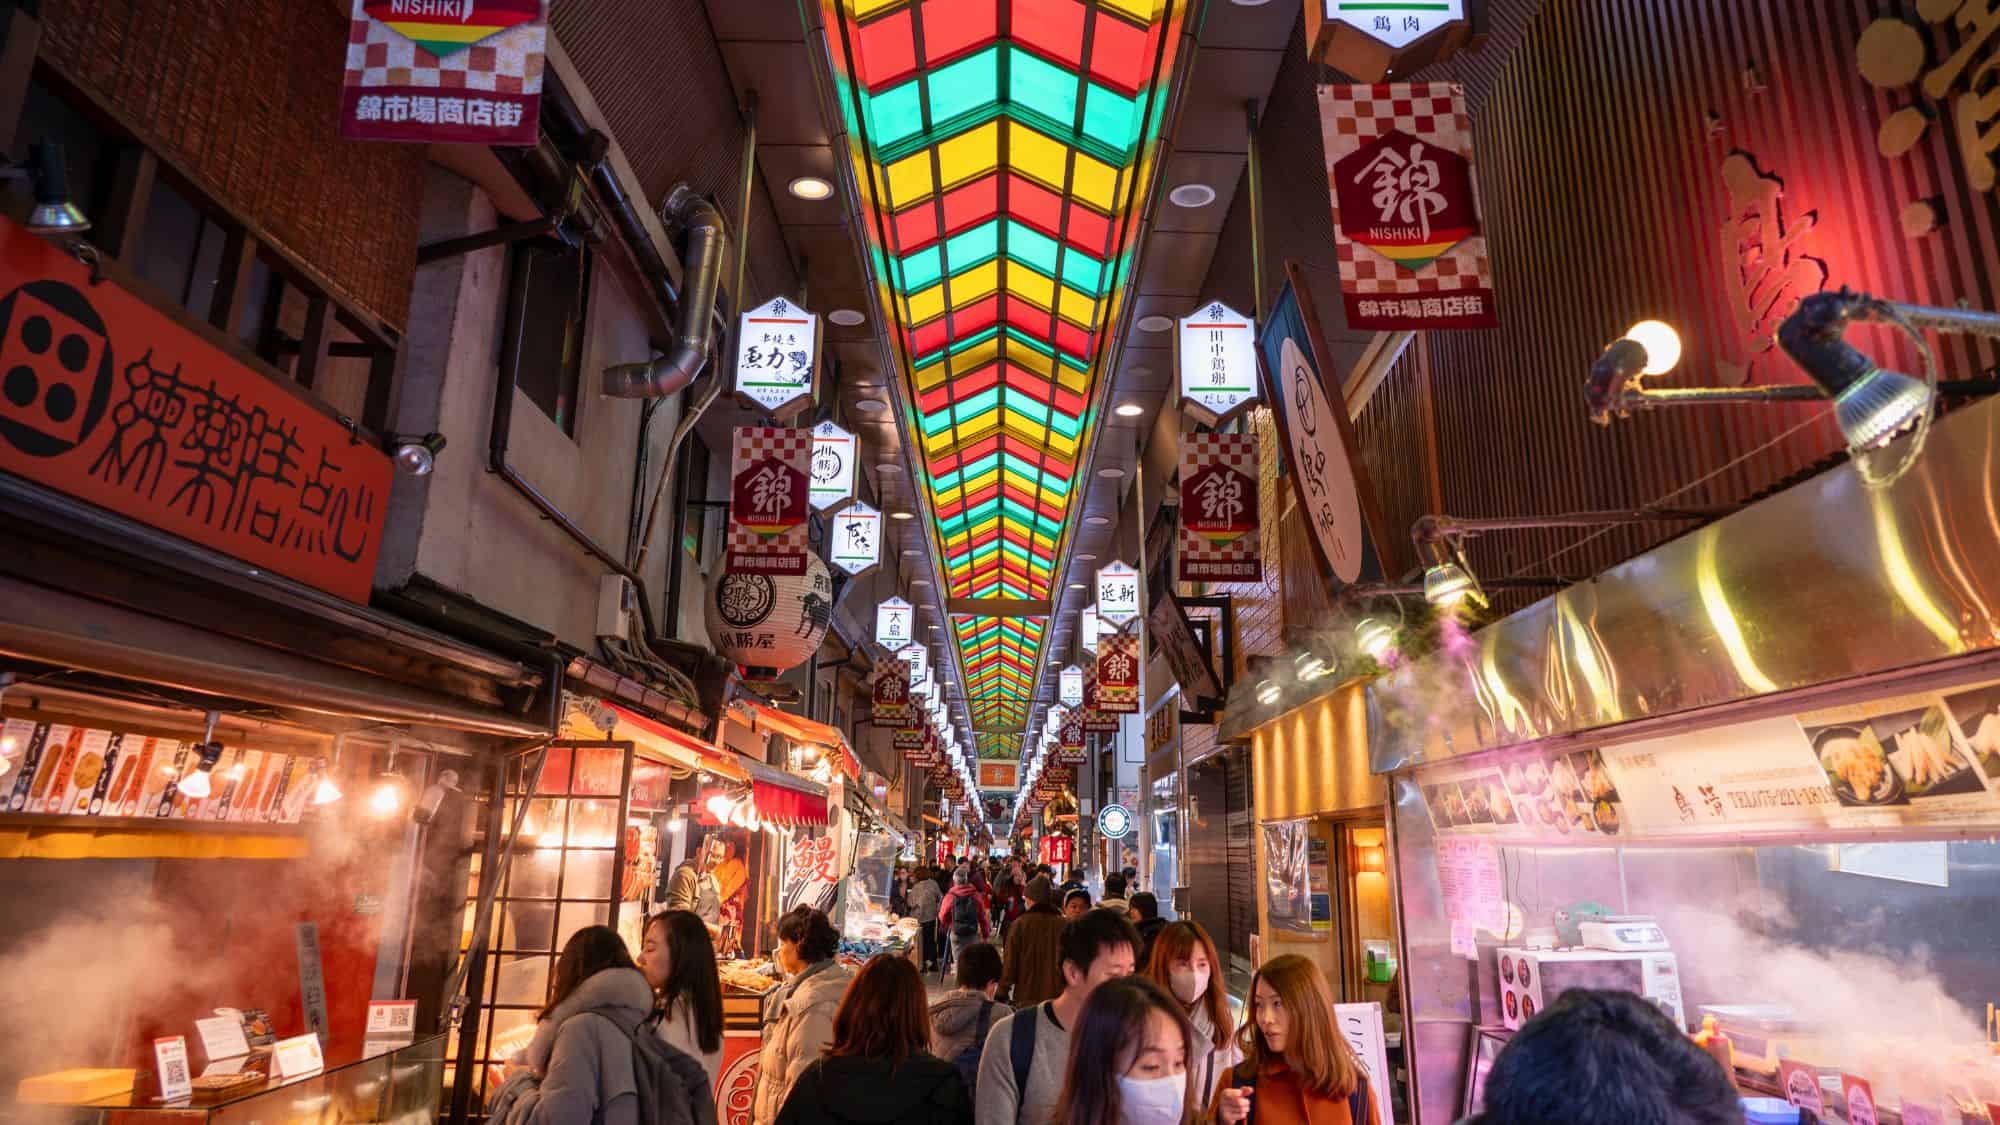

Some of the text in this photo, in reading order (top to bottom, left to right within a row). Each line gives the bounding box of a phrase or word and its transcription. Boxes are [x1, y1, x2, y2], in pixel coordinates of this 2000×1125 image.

[391, 0, 461, 17] NISHIKI
[1372, 16, 1420, 32] 鶏肉
[355, 95, 523, 127] 錦市場商店街
[1353, 142, 1449, 242] 錦
[1369, 226, 1421, 241] NISHIKI
[1357, 296, 1484, 320] 錦市場商店街
[744, 464, 793, 525] 錦
[1191, 470, 1244, 531] 錦
[1103, 653, 1131, 686] 錦
[791, 834, 838, 883] 鰻
